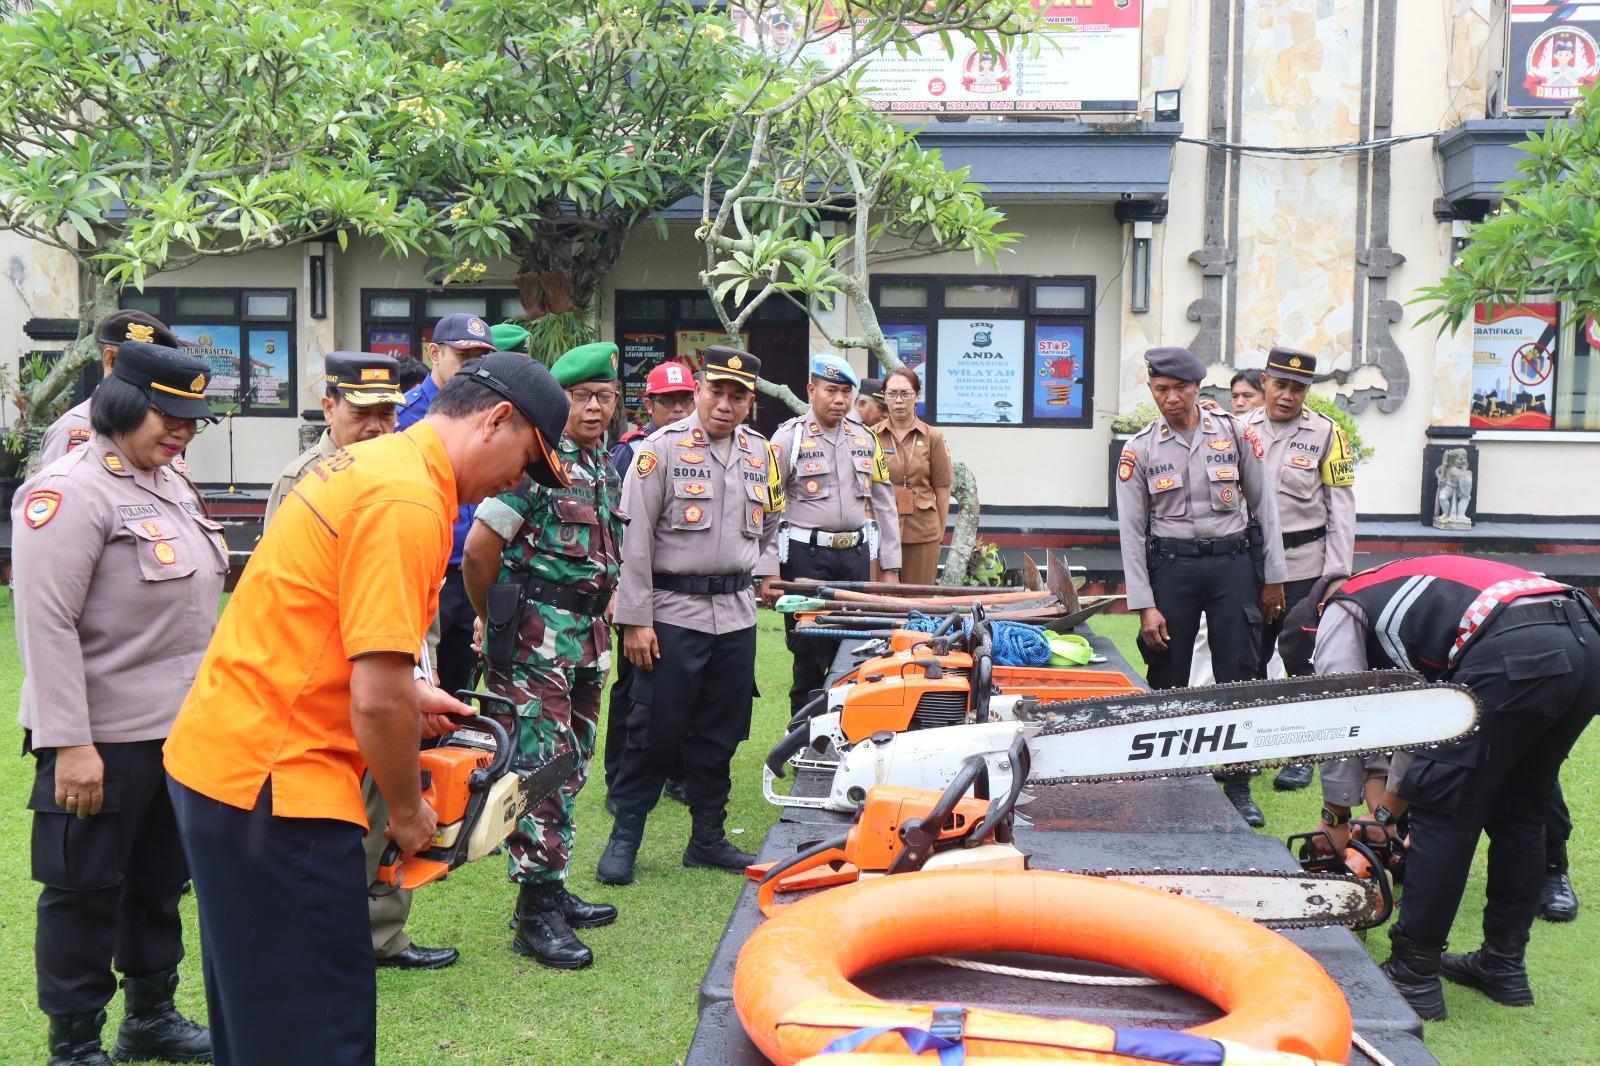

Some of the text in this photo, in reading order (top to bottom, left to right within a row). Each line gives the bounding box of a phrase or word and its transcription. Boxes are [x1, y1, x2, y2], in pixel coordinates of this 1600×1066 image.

[891, 101, 944, 111] KORUPSI,
[946, 101, 988, 110] KOLUSI
[990, 102, 1014, 110] DAN
[1016, 102, 1081, 110] NEPOTISME
[962, 351, 1004, 360] ANDA
[948, 369, 1016, 377] WILAYAH
[1289, 441, 1320, 453] POLRI
[1206, 453, 1238, 464] POLRI
[1149, 463, 1175, 475] SENA
[1281, 724, 1306, 733] Germany
[1254, 725, 1361, 748] DUROMATIC E
[1128, 723, 1248, 761] STIHL
[1256, 900, 1265, 908] E
